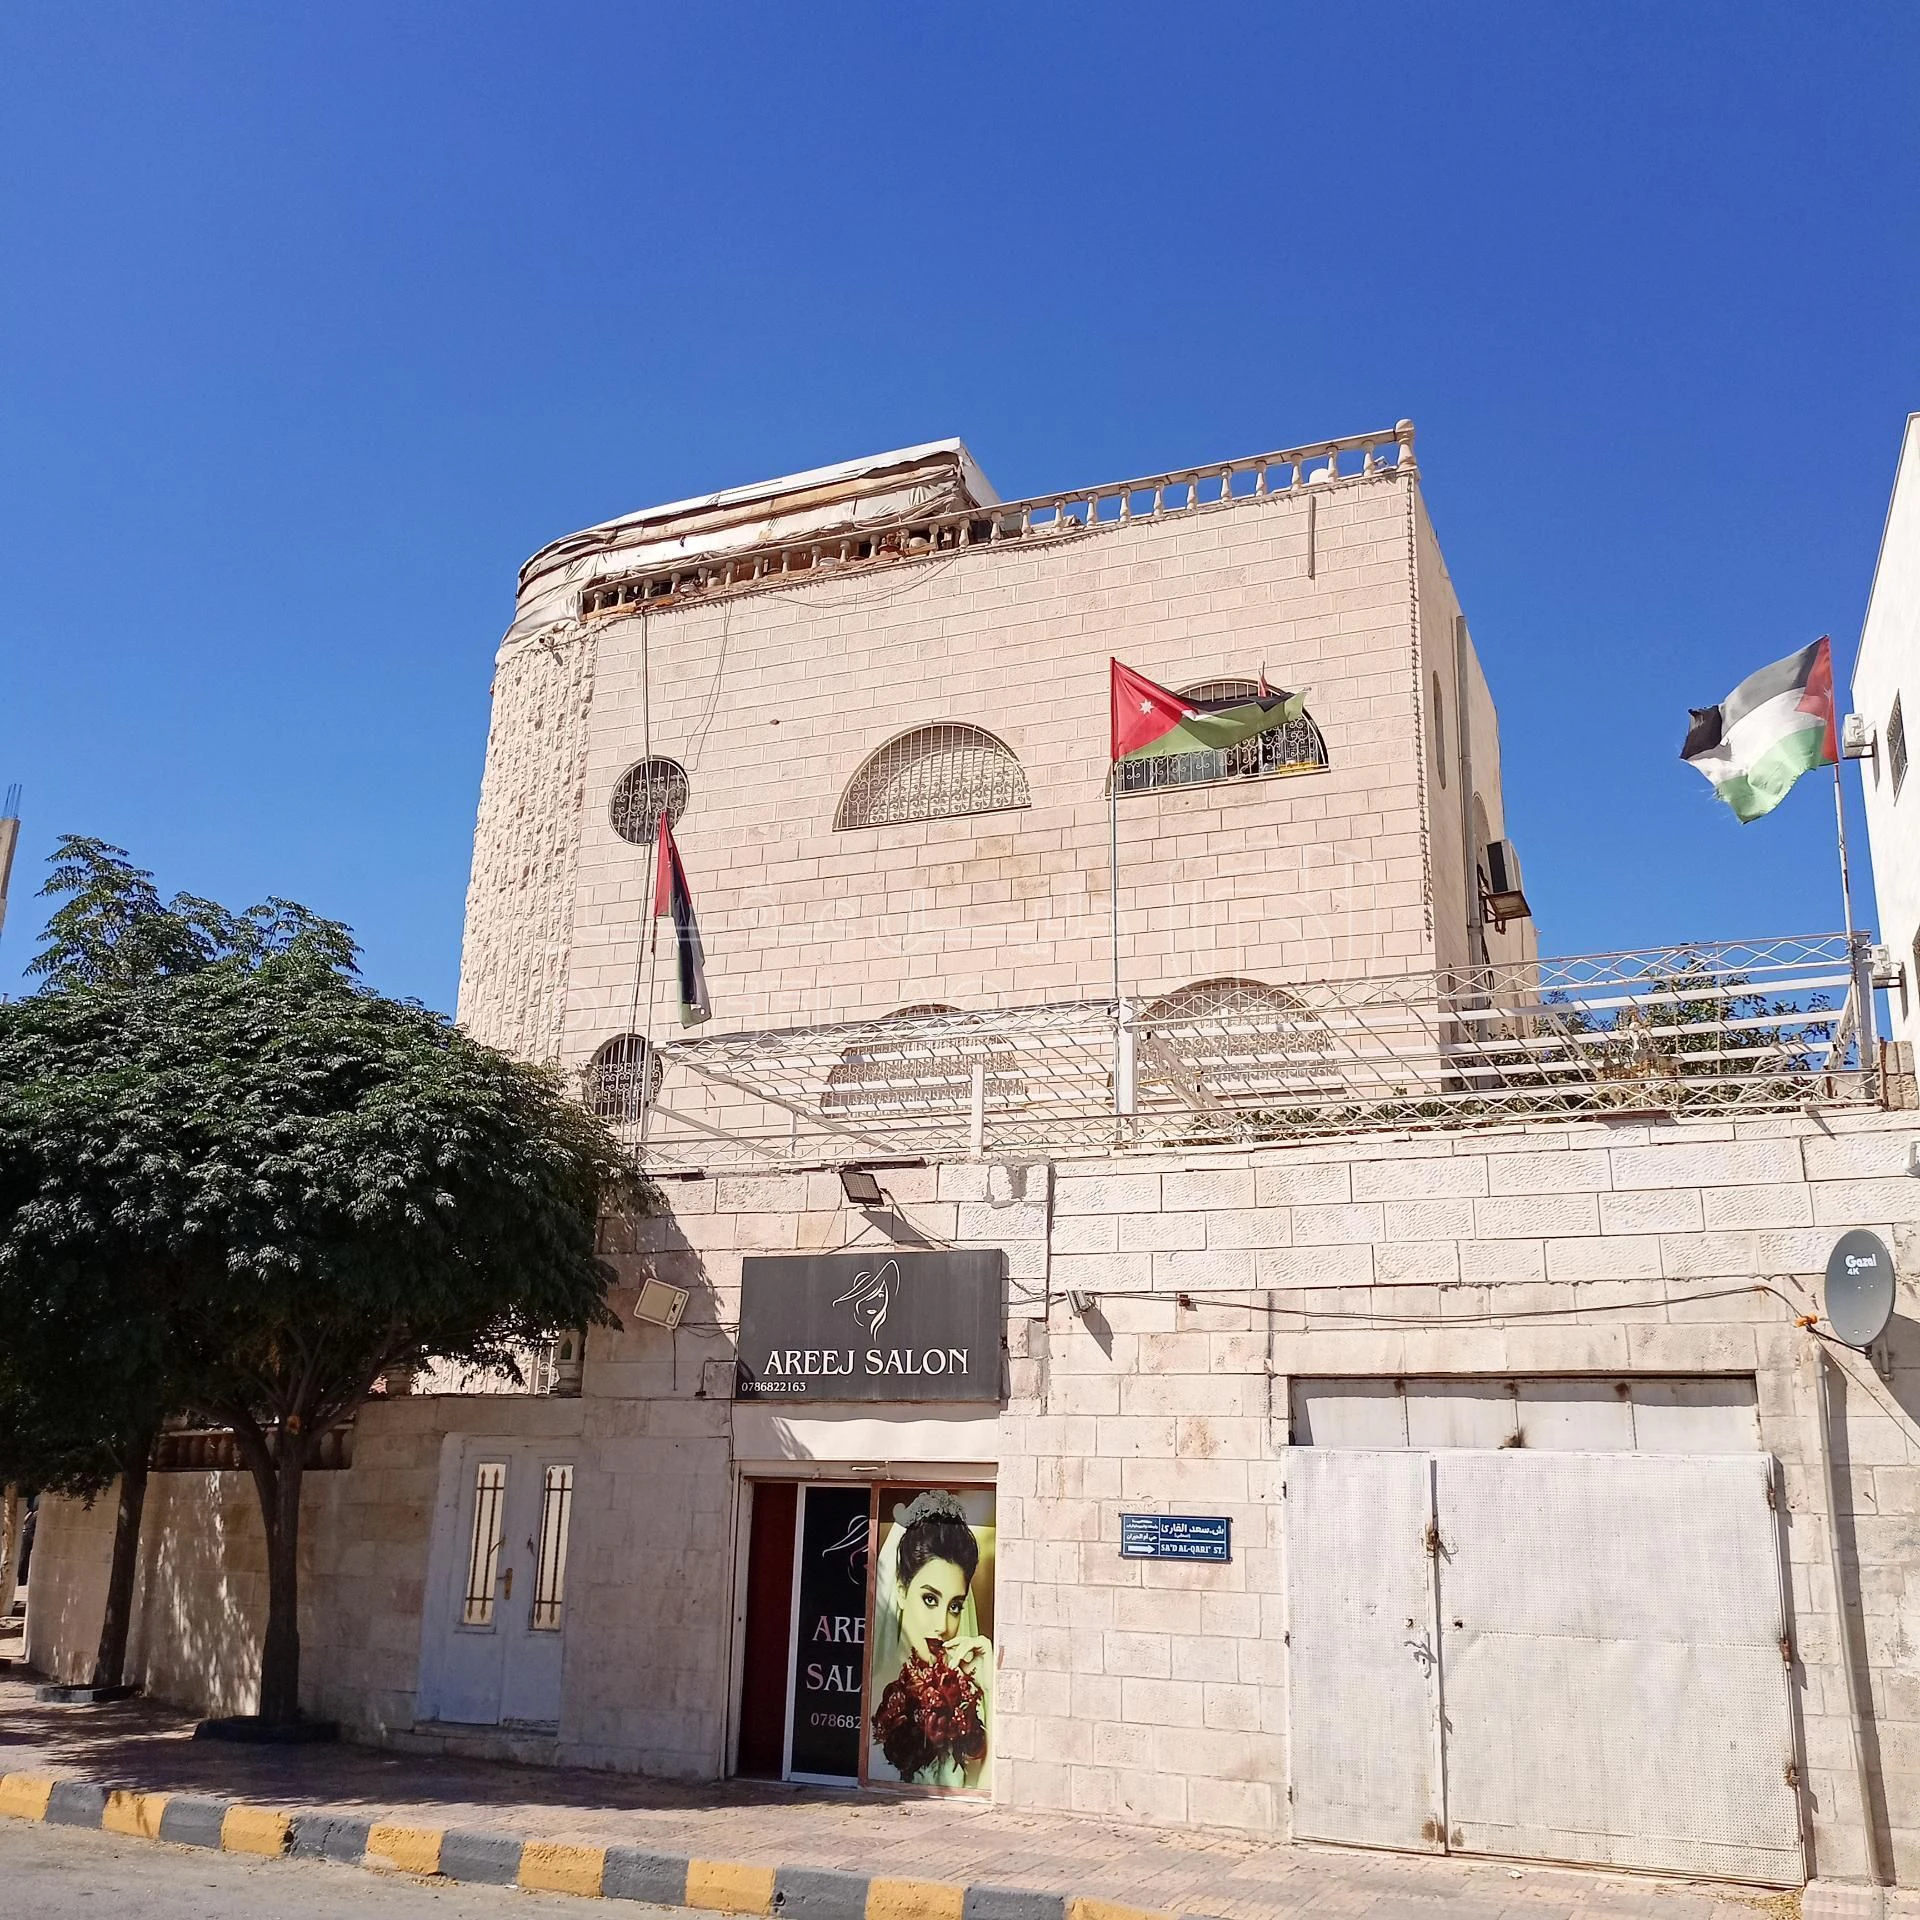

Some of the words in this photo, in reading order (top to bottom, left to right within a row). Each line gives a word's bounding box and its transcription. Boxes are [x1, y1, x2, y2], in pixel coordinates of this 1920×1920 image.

[1847, 1268, 1860, 1276] 4K
[763, 1349, 855, 1376] AREEJ
[864, 1348, 969, 1375] SALON
[741, 1382, 807, 1392] 0786822163
[806, 1663, 862, 1692] SAL
